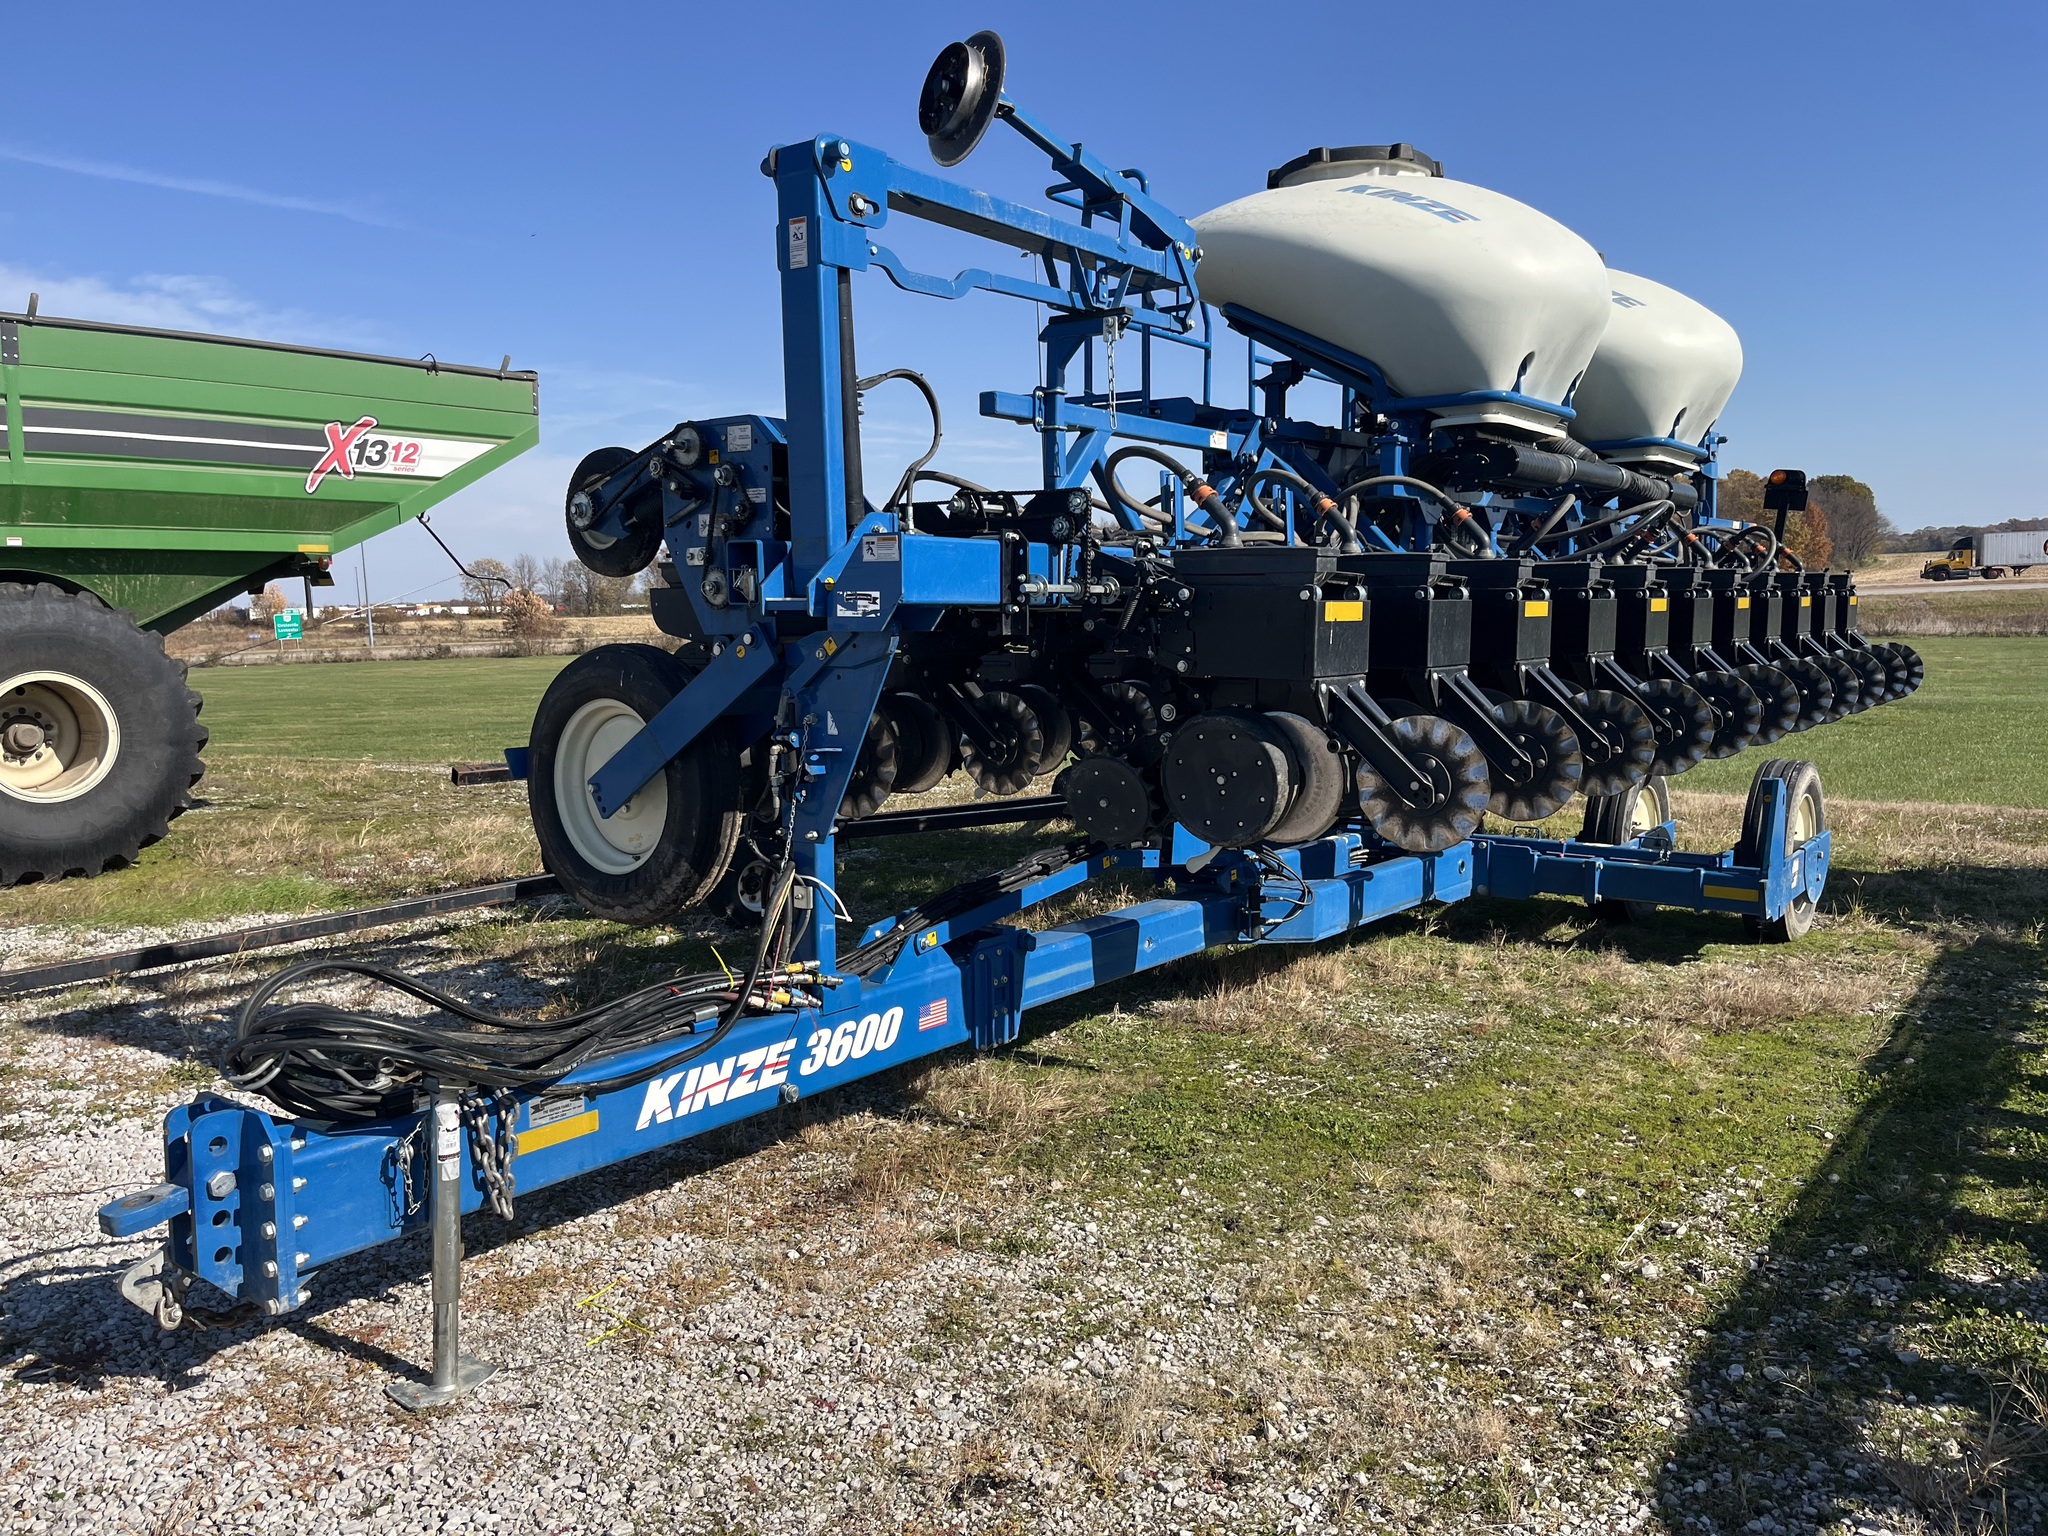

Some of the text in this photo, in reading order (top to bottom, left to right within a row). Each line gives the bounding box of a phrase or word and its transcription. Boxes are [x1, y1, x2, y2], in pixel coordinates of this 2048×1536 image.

[1336, 185, 1481, 223] KINZE
[393, 465, 415, 473] series
[635, 1006, 904, 1131] KINZE 3600
